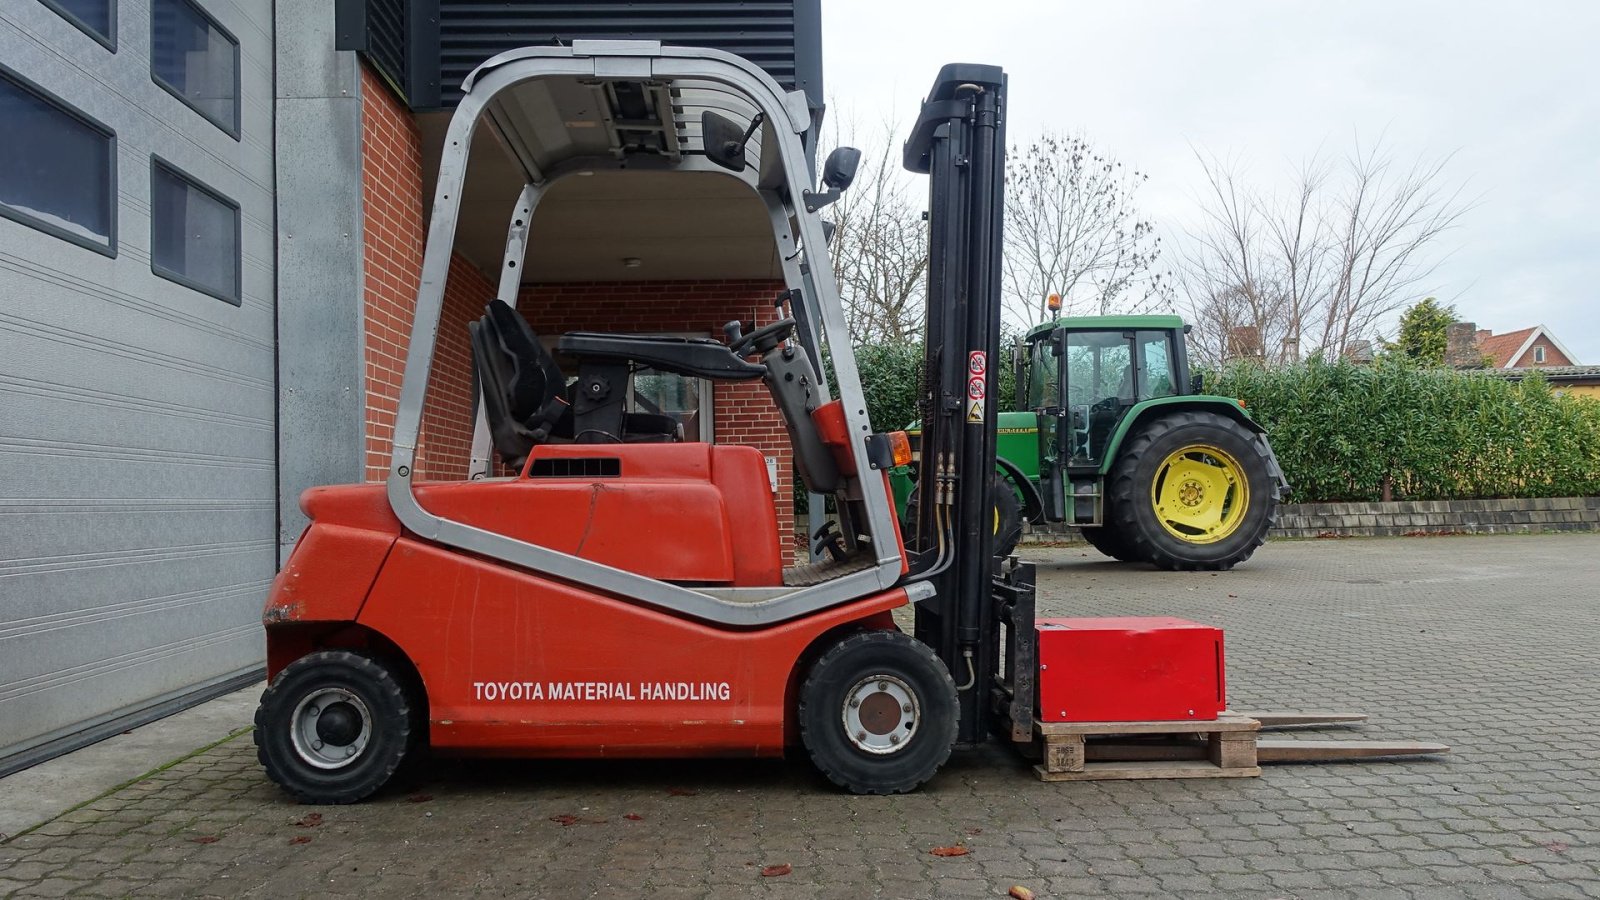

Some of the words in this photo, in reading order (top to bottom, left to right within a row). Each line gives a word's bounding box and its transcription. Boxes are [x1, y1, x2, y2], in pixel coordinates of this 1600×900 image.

[473, 682, 544, 700] TOYOTA
[548, 682, 636, 700] MATERIAL
[640, 682, 730, 700] HANDLING
